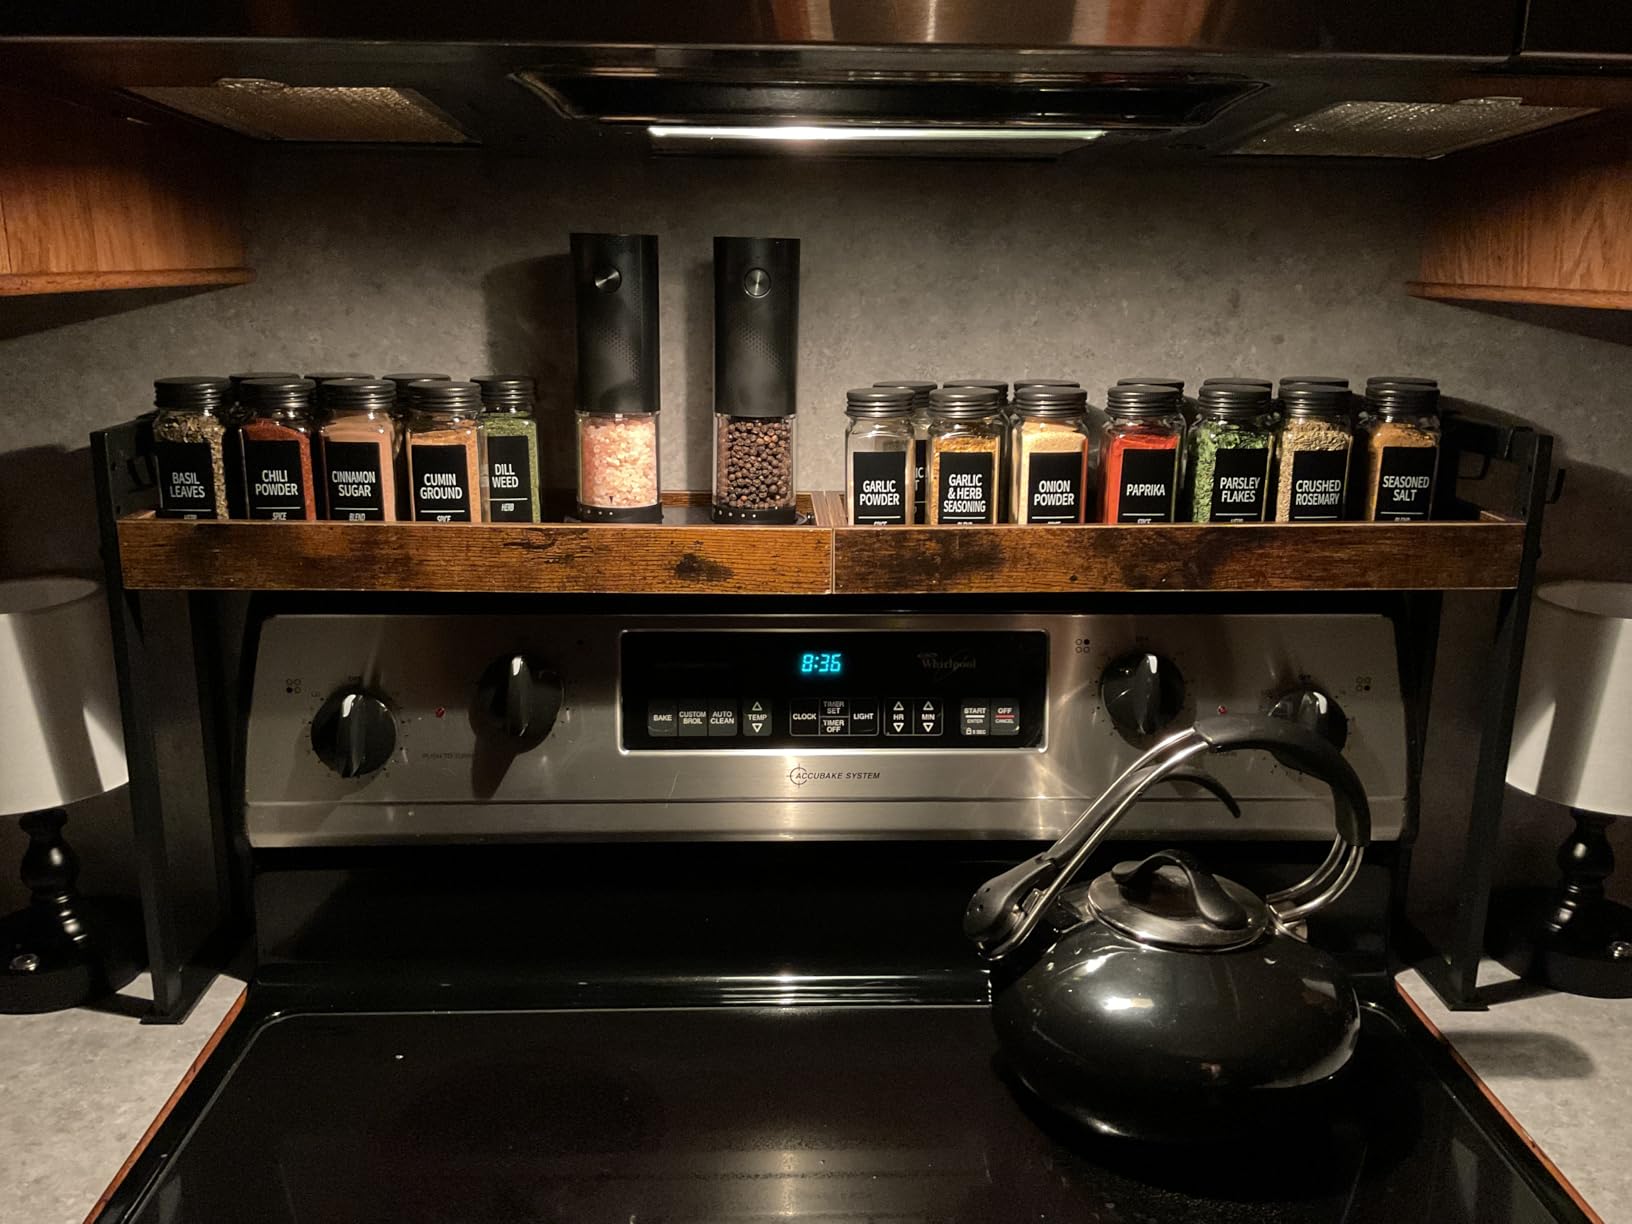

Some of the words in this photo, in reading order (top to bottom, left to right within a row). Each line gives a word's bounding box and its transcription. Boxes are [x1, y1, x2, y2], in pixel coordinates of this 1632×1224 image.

[261, 469, 289, 483] CHILI
[494, 463, 516, 476] DILL
[172, 472, 200, 485] BASIL
[331, 470, 376, 484] CINNAMON
[423, 473, 457, 486] CUMIN
[491, 476, 519, 488] WEED
[948, 474, 983, 487] GARLIC
[1219, 476, 1261, 490] PARSLEY
[1382, 475, 1430, 489] SEASONED
[169, 486, 206, 498] LEAVES
[255, 483, 299, 496] POWDER
[338, 484, 372, 497] SUGAR
[862, 480, 897, 493] GARLIC
[1038, 480, 1071, 493] ONION
[1126, 483, 1166, 496] PAPRIKA
[1295, 479, 1342, 492] CRUSHED
[420, 487, 463, 500] GROUND
[859, 493, 900, 506] POWDER
[947, 488, 956, 500] &
[956, 488, 983, 500] HERB
[1034, 493, 1075, 506] POWDER
[1221, 490, 1256, 503] FLAKES
[1295, 493, 1341, 506] ROSEMARY
[1392, 489, 1418, 502] SALT
[943, 500, 987, 513] SEASONING
[272, 512, 287, 521] SPICE
[348, 512, 366, 522] BLEND
[801, 653, 842, 673] 8:36
[748, 713, 768, 721] TEMP
[792, 713, 817, 721] CLOCK
[826, 707, 841, 715] SET
[853, 713, 874, 721] LIGHT
[893, 713, 904, 721] HR
[921, 713, 935, 721] MIN
[653, 714, 673, 722] BAKE
[683, 717, 703, 725] BROIL
[710, 717, 735, 725] CLEAN
[822, 719, 845, 727] TIMER
[795, 772, 843, 780] ACCUBAKE
